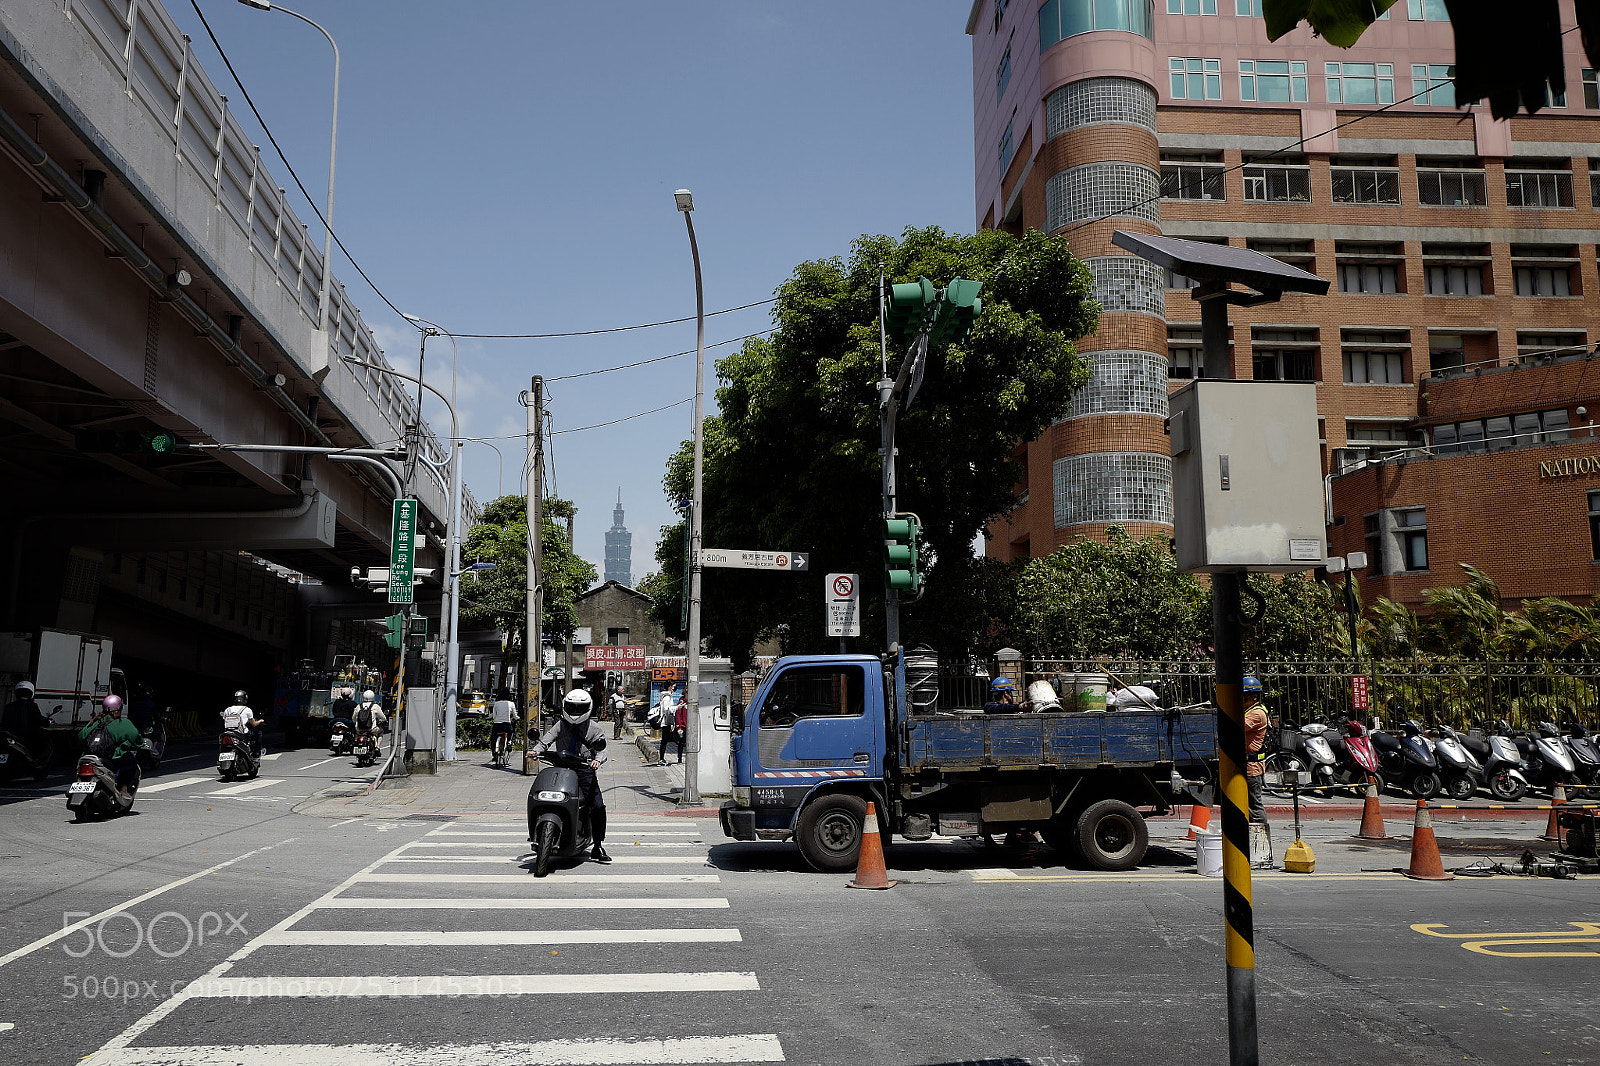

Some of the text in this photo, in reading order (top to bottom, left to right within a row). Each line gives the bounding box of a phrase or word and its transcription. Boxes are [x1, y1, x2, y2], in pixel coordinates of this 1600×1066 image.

[398, 508, 410, 563] 基隆路三段
[706, 554, 727, 563] 800m
[653, 669, 662, 679] P
